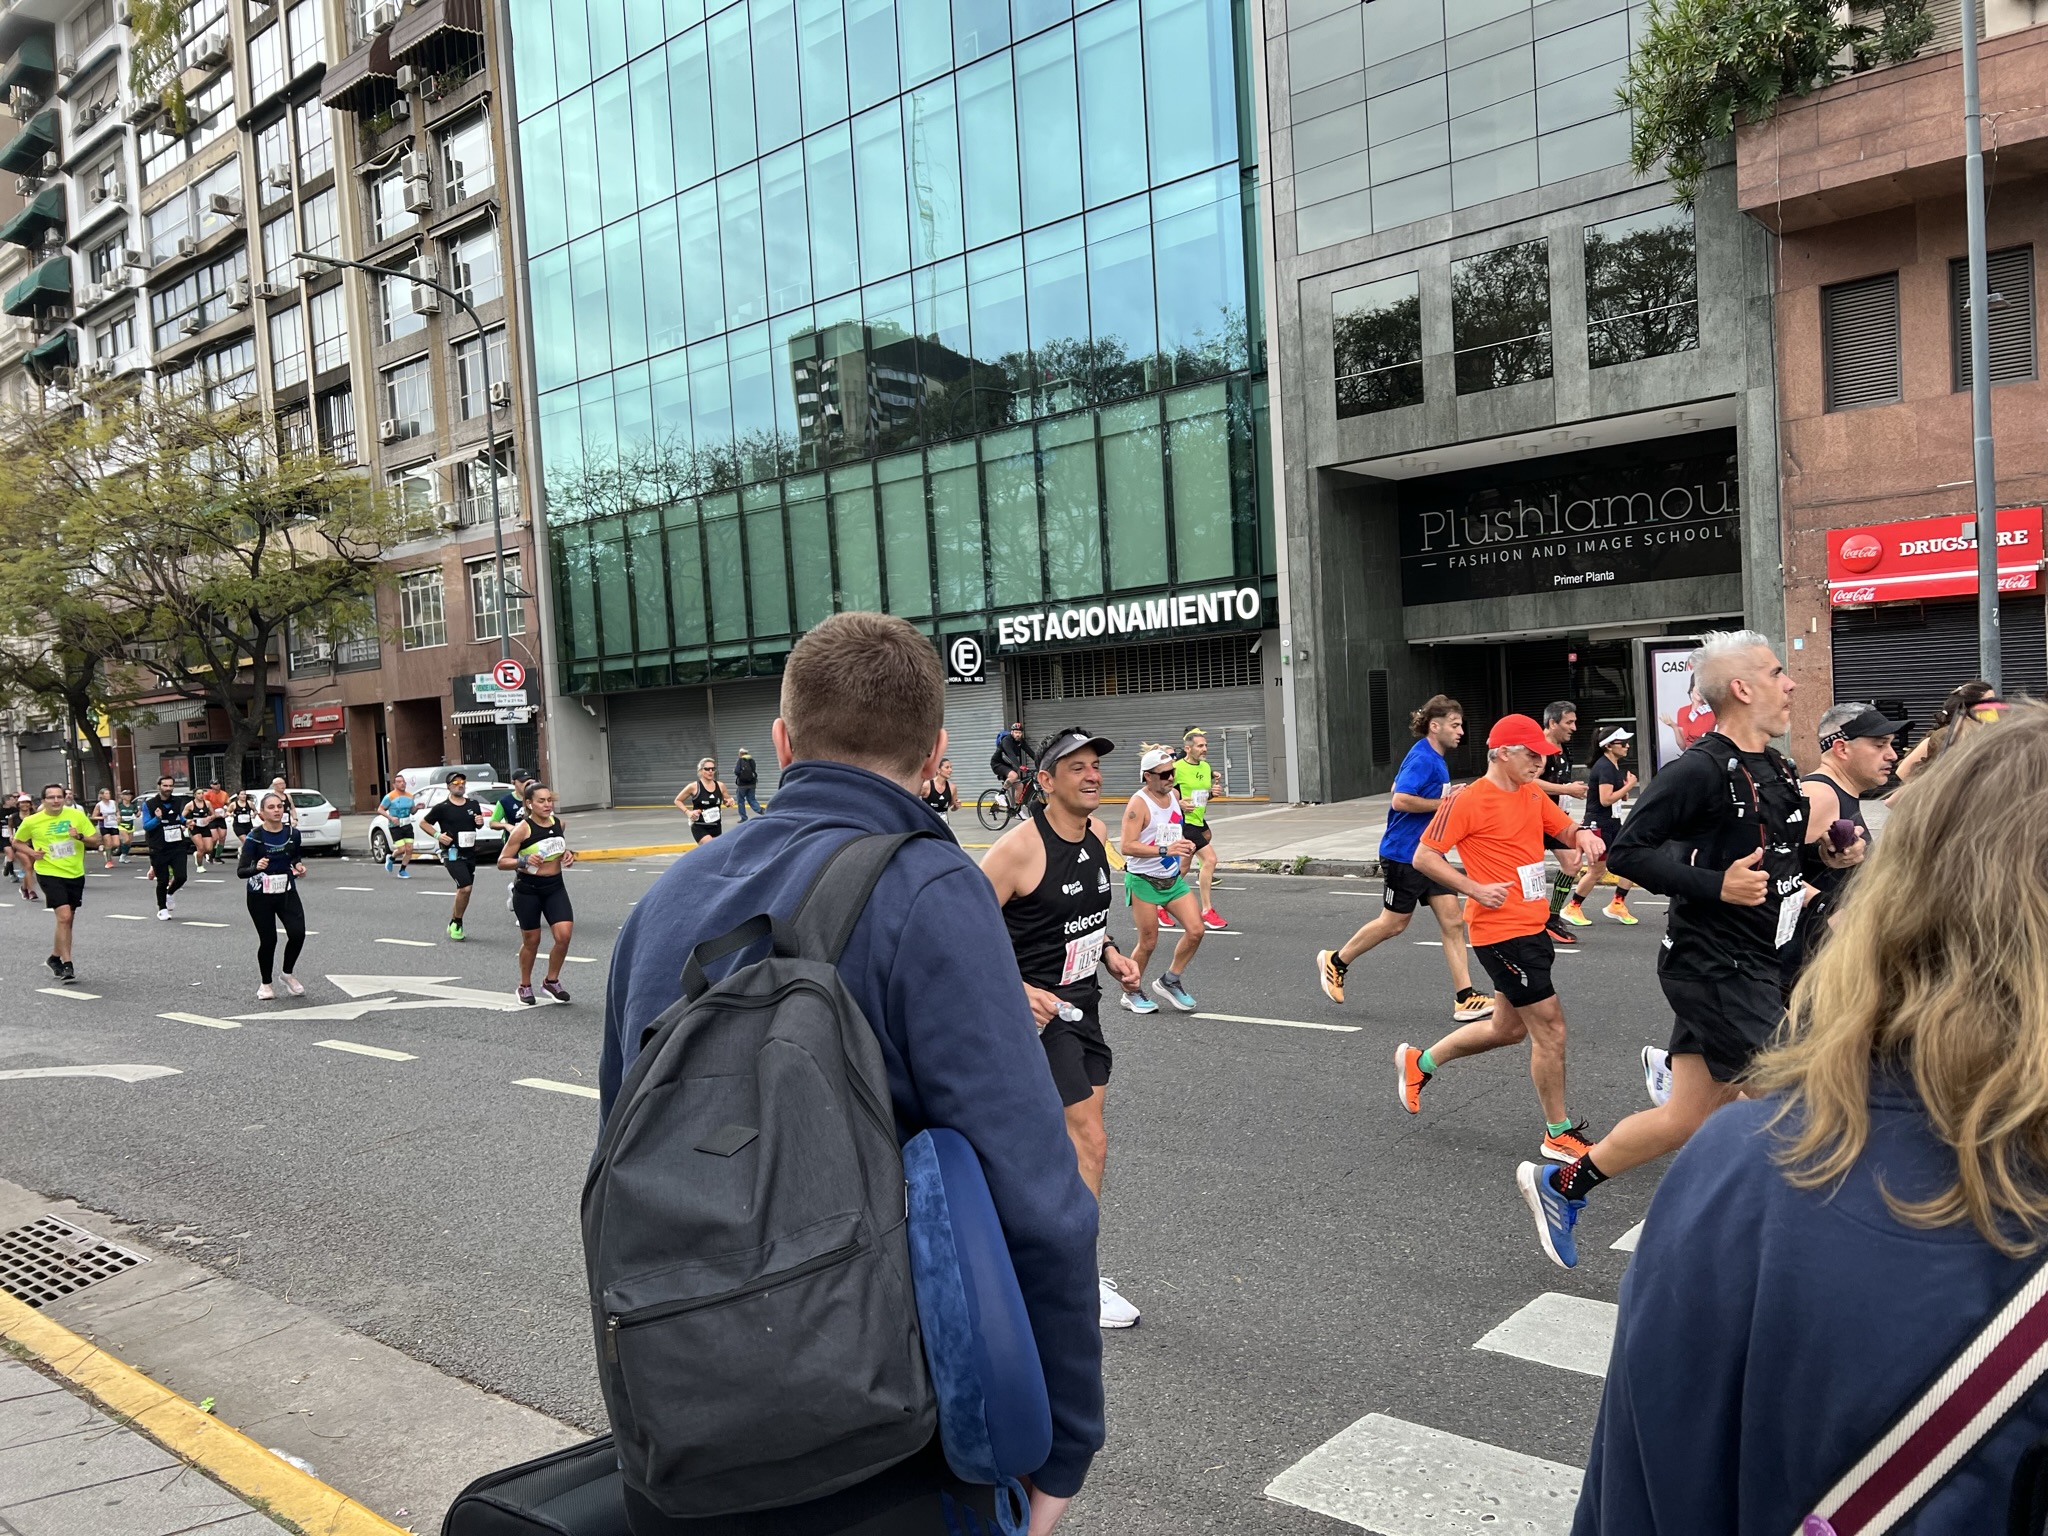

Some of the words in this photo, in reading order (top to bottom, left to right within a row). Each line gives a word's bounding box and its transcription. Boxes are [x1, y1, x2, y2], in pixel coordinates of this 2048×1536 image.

[1419, 479, 1740, 552] Plushlamou
[1448, 549, 1524, 570] FASHION
[1532, 545, 1567, 560] AND
[1576, 536, 1633, 554] IMAGE
[1644, 526, 1724, 547] SCHOOL
[1553, 573, 1584, 586] Primer
[1585, 570, 1615, 583] Planta
[998, 586, 1261, 647] ESTACIONAMIENTO
[957, 644, 975, 670] E
[1656, 1071, 1664, 1091] FILA
